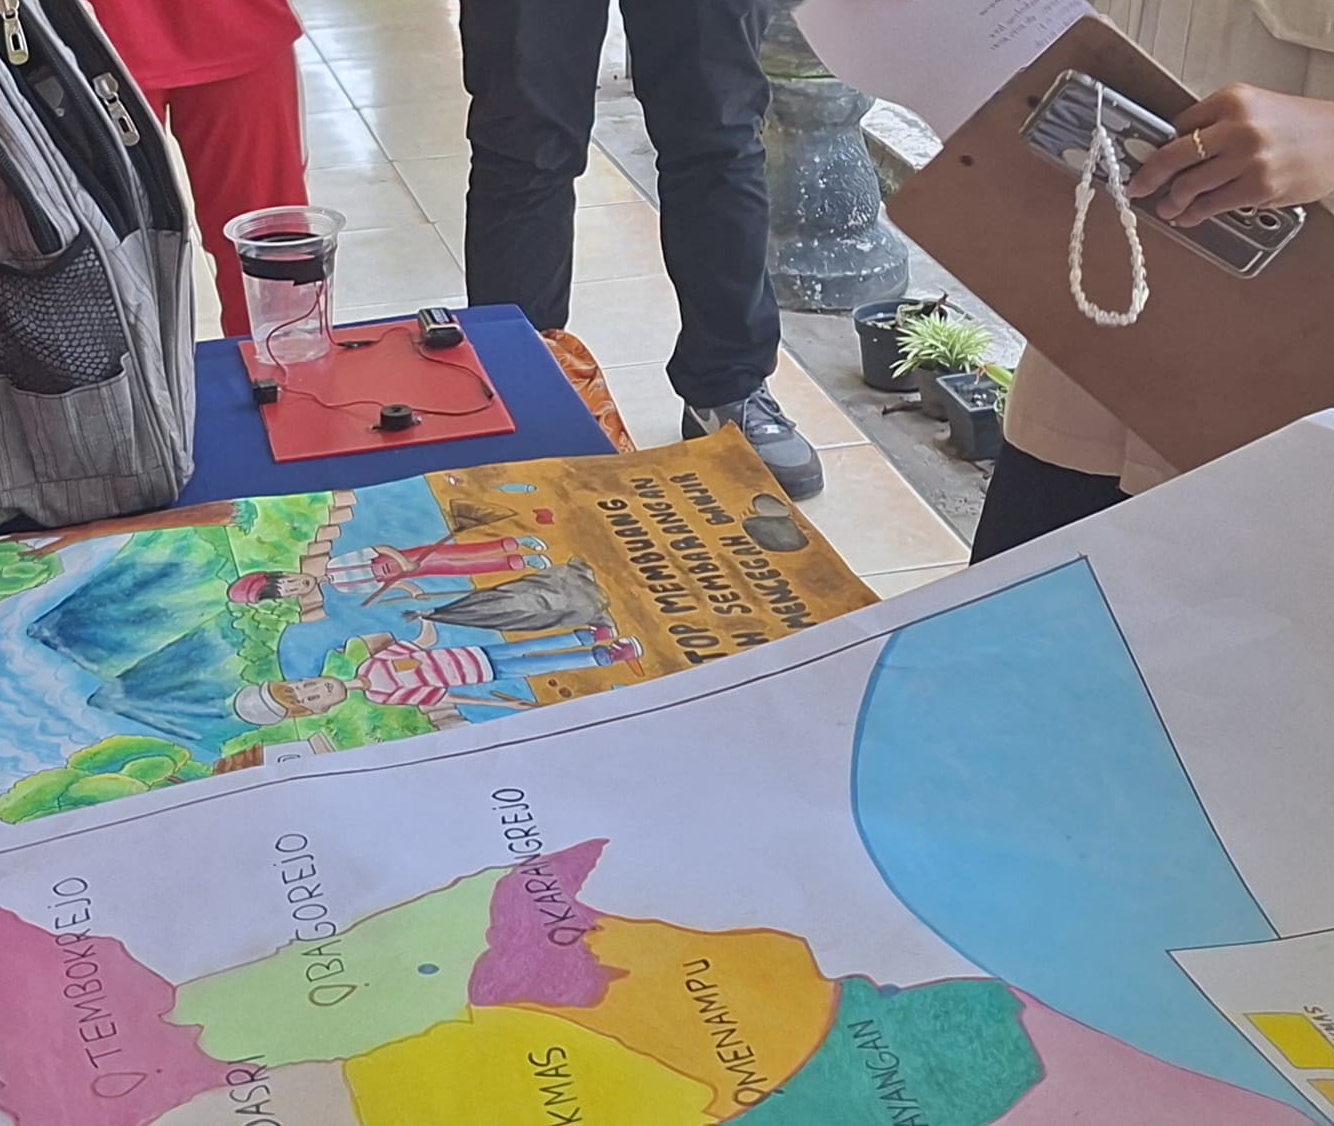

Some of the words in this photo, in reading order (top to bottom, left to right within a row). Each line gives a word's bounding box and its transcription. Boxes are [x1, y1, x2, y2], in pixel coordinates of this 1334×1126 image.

[597, 497, 699, 614] MEMBUANG
[629, 476, 753, 617] SEMBARANGAN
[670, 471, 735, 527] BANJIR
[719, 534, 818, 630] MENCEGAH
[272, 833, 345, 983] BAGOREJO
[491, 788, 576, 926] KARANGREJO
[46, 876, 122, 1069] TEMBOKREJO
[683, 958, 768, 1091] MENAMPU
